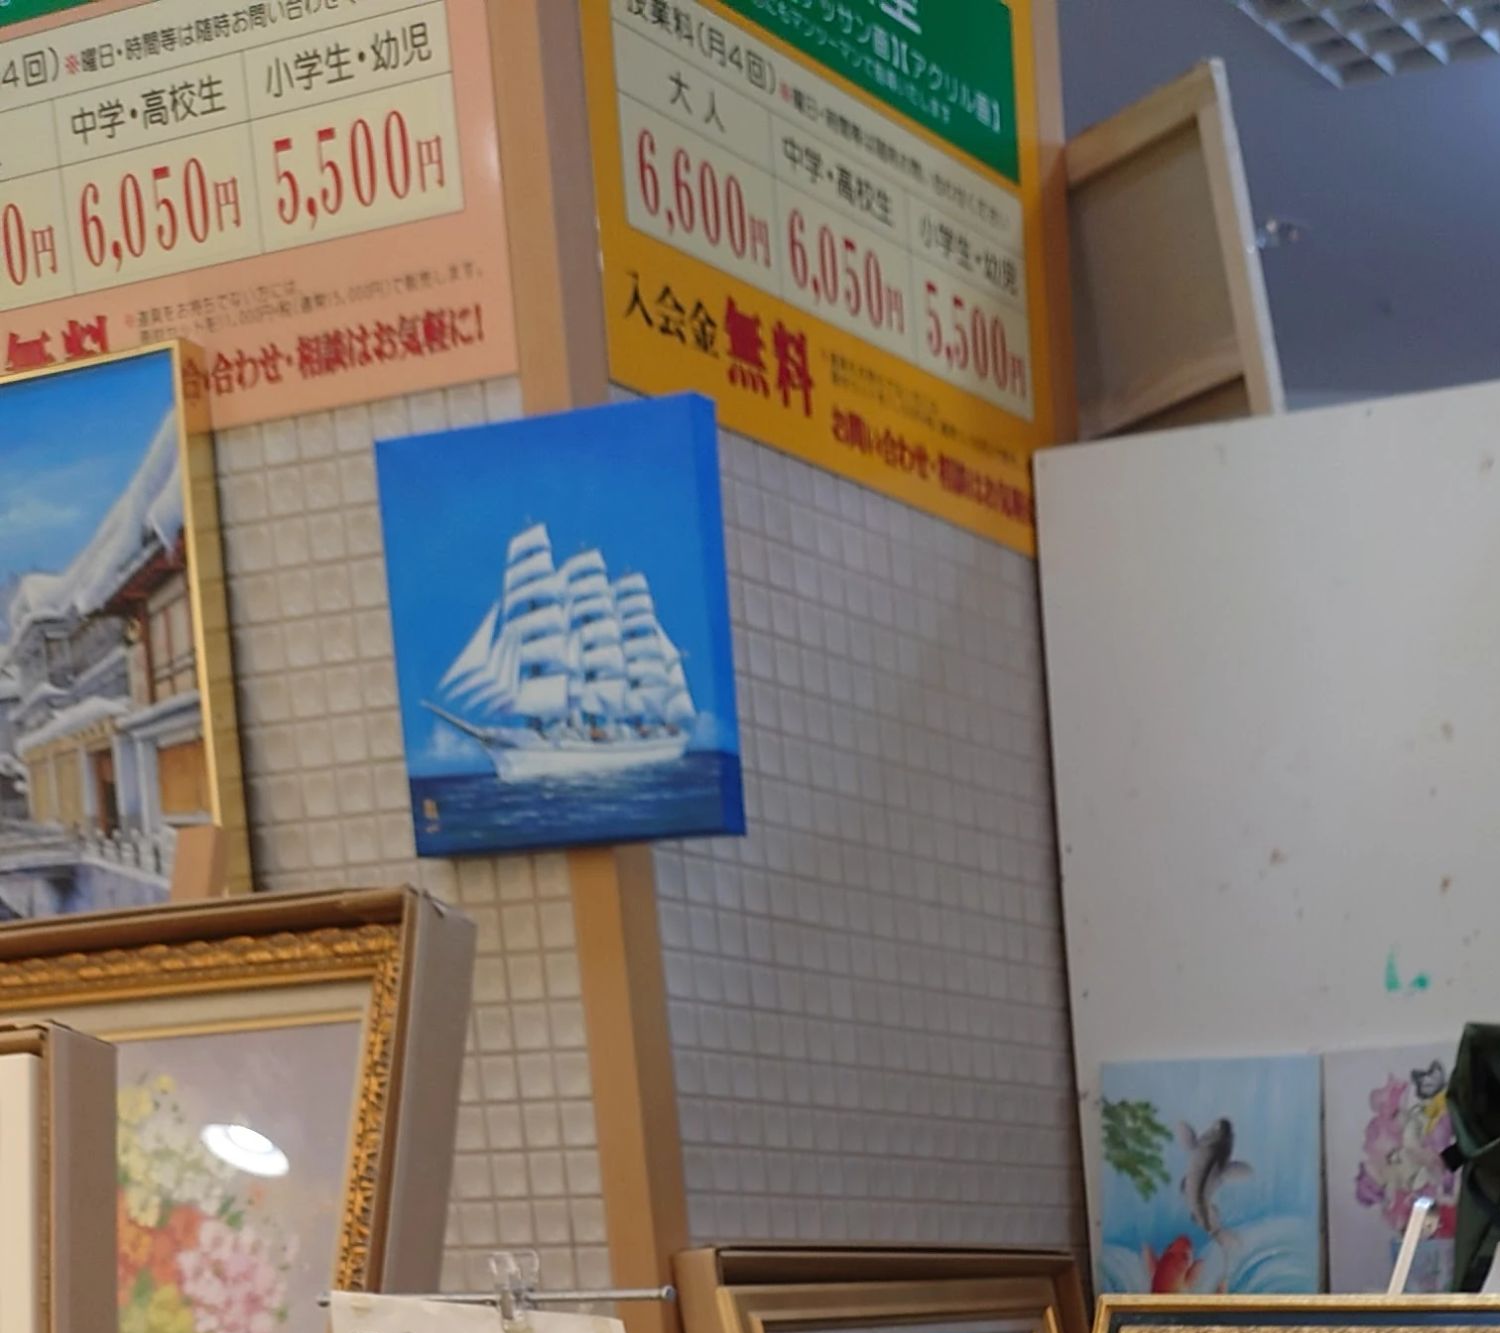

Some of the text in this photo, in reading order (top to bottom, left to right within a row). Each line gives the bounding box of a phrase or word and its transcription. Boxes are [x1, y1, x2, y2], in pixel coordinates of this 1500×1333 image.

[70, 21, 432, 146] 中学・高校生 小学生・幼児
[80, 157, 242, 273] 6,050円
[273, 109, 447, 231] 5,500円
[637, 129, 1027, 399] 6,600円 6,050円 5,500円
[668, 70, 1019, 298] 大人 中学・高校生 小学生・幼児
[203, 304, 485, 397] 合わせ・相談はお気軽に!
